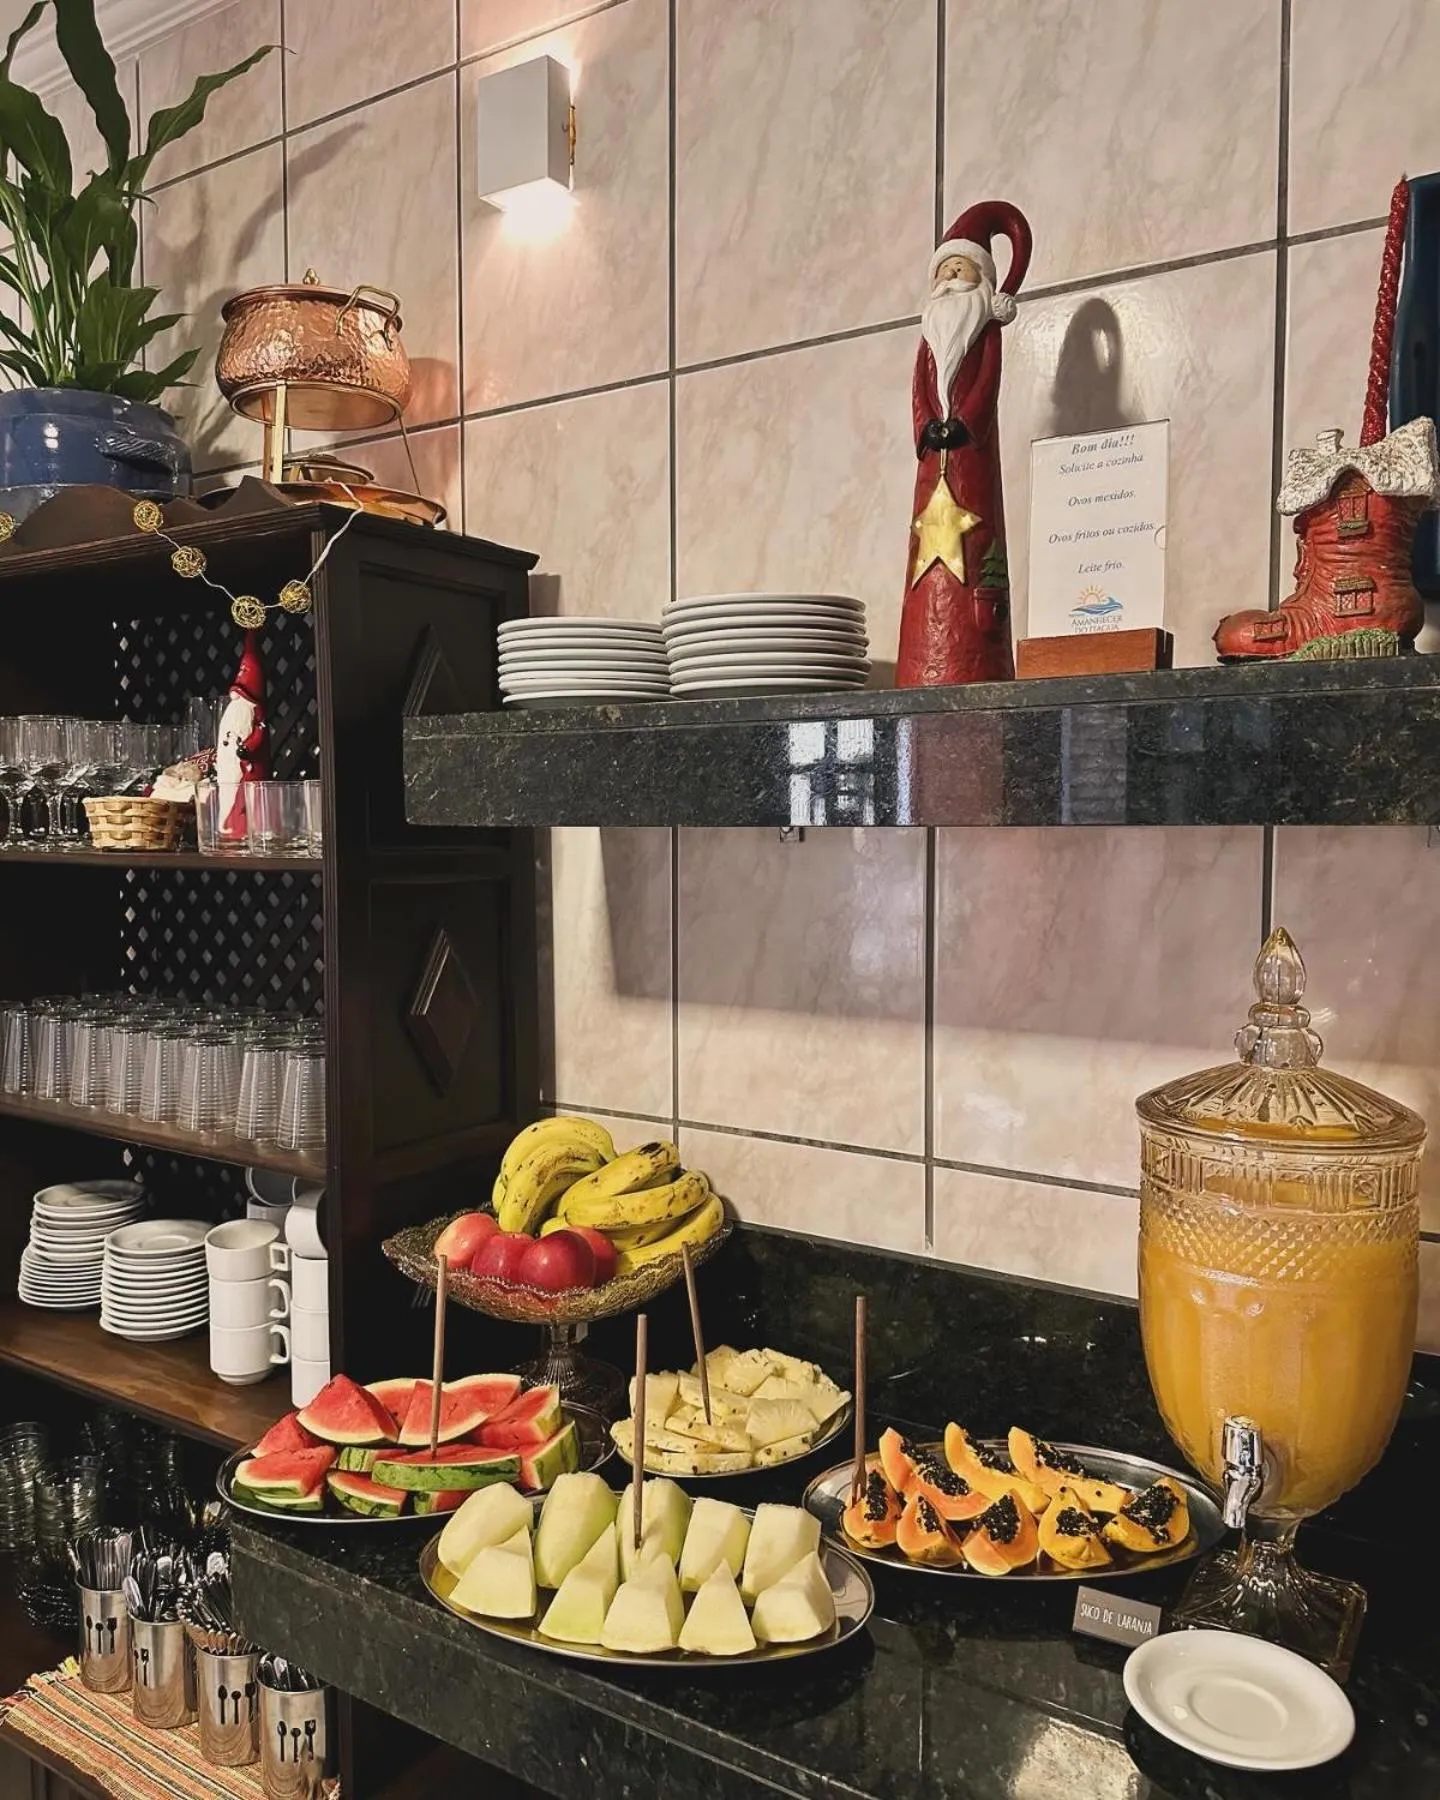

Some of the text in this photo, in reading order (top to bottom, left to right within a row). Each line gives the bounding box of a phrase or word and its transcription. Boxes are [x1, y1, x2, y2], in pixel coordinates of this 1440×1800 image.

[1072, 433, 1135, 455] Bom dia!!!
[1059, 463, 1095, 475] Solicite
[1106, 453, 1143, 467] cozinha
[1068, 495, 1092, 507] Ovos
[1048, 533, 1072, 544] Ovos
[1074, 530, 1100, 543] fritos
[1102, 528, 1115, 537] ou
[1078, 563, 1102, 574] Leite
[1080, 1603, 1152, 1635] SUCO DE LARANJA
